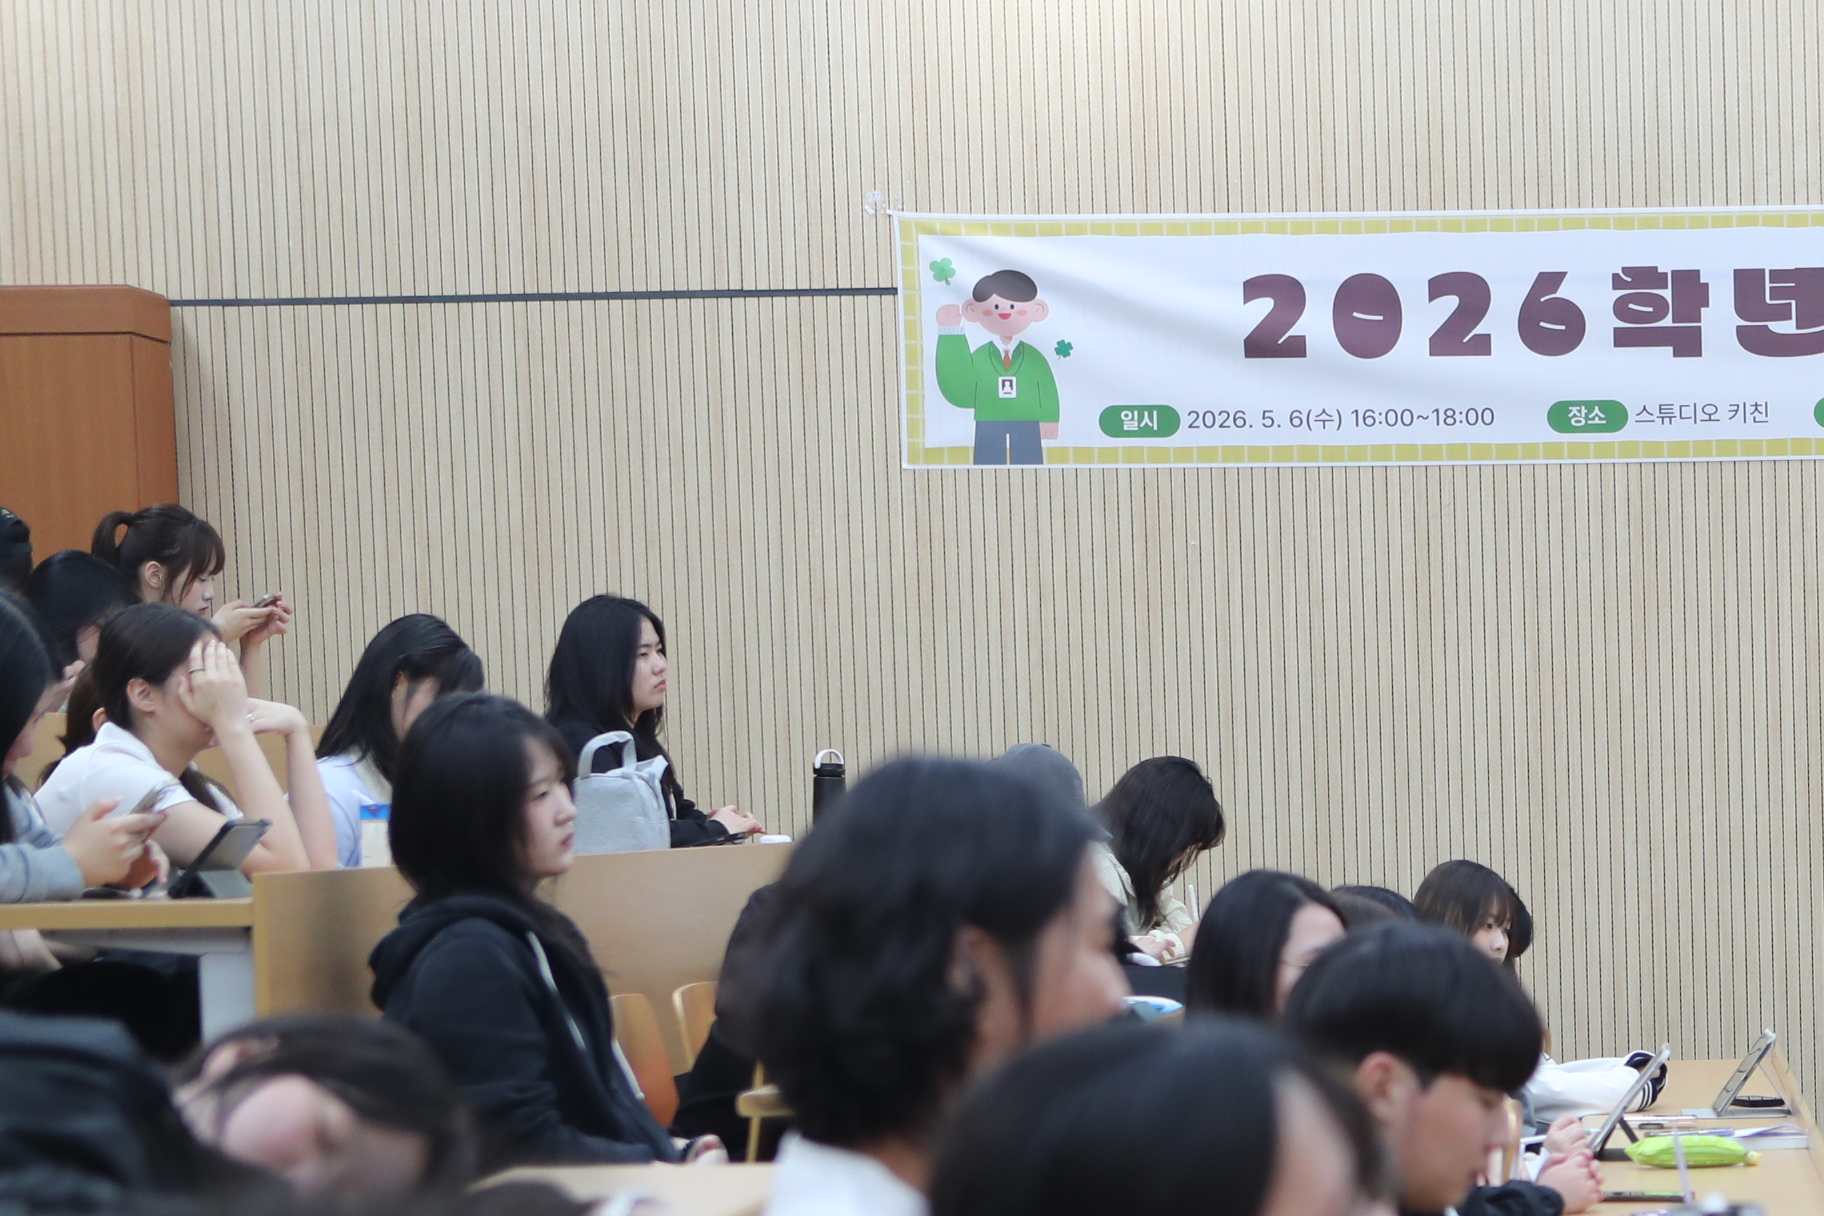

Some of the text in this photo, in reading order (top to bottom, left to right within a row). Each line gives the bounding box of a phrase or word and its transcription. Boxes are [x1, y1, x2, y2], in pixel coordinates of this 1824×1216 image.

[1120, 407, 1494, 431] 일시 2026. 5. 6(수) 16:00~18:00
[1568, 402, 1768, 427] 장소 스튜디오 키친
